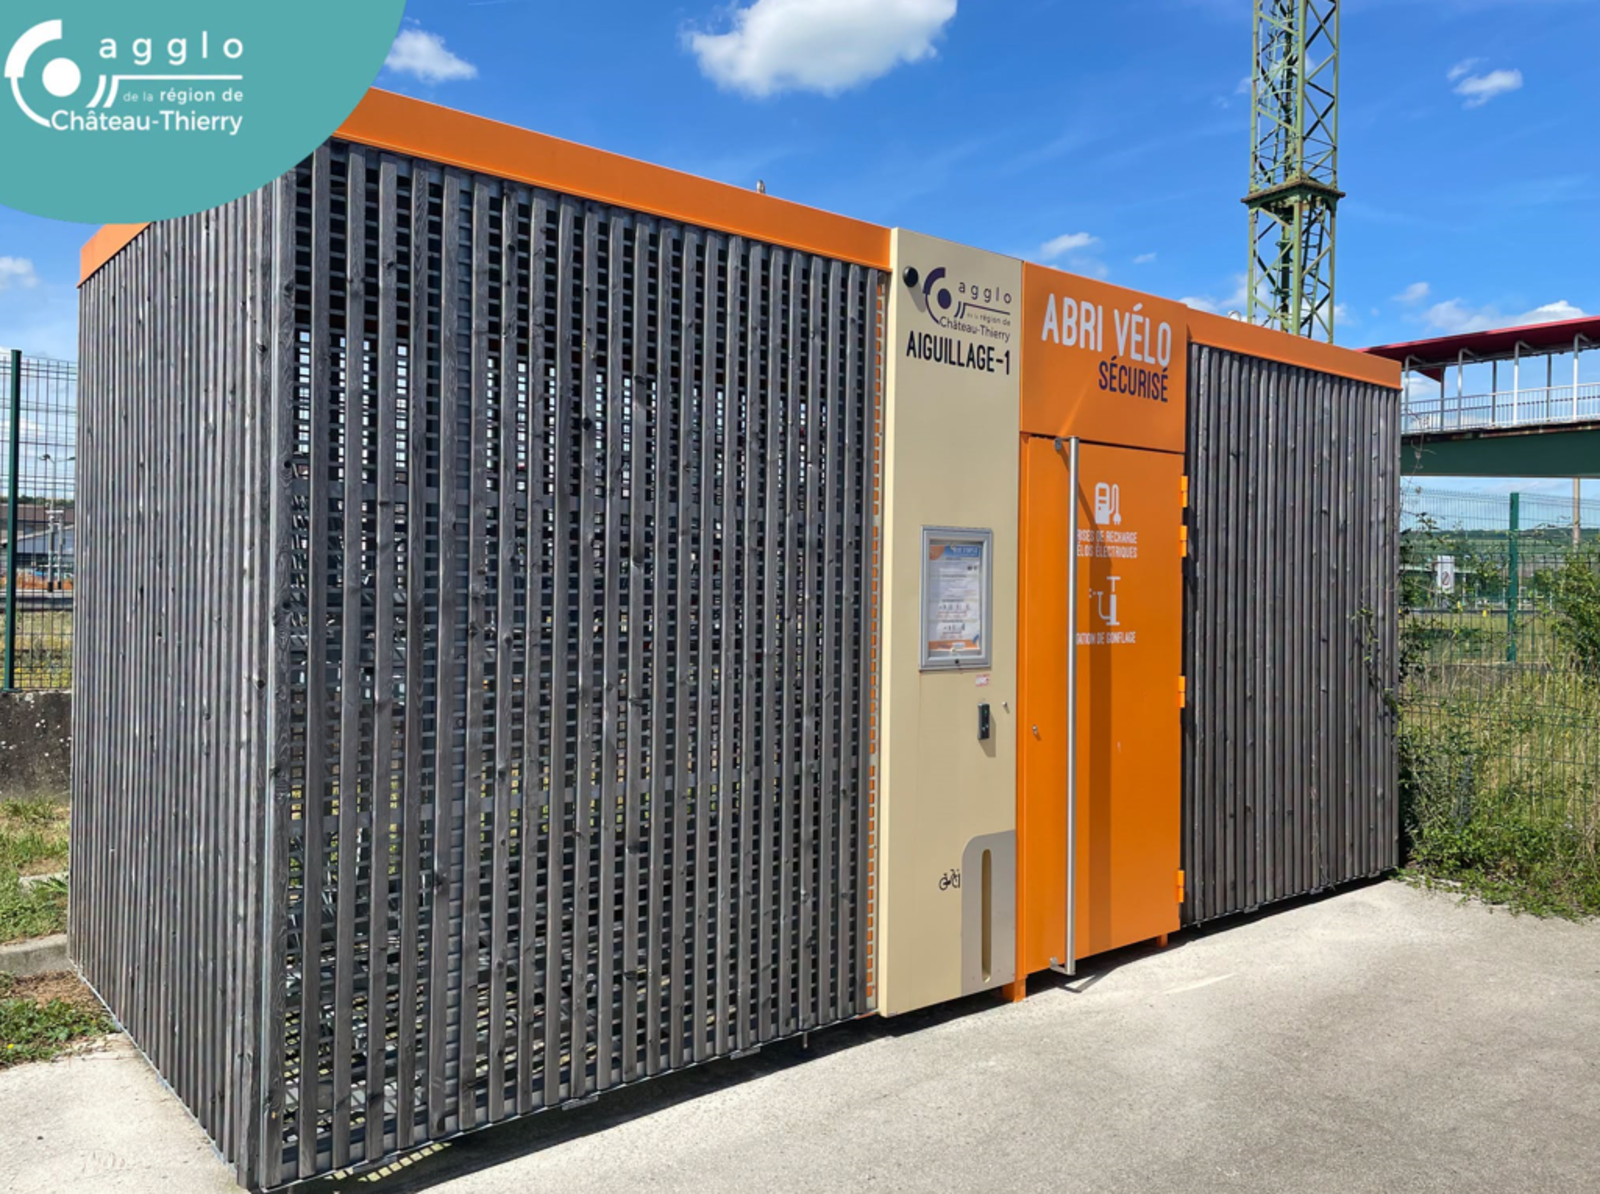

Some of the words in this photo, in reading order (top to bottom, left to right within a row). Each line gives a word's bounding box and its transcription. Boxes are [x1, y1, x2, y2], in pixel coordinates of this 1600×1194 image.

[958, 281, 1012, 304] agglo
[939, 316, 1011, 343] Château-Thierry
[1041, 293, 1103, 352] ABRI
[1114, 302, 1172, 367] VÉLO
[906, 330, 1010, 375] AIGUILLAGE-1
[1098, 355, 1168, 403] SÉCURISÉ
[1077, 541, 1094, 557] ÉLOS
